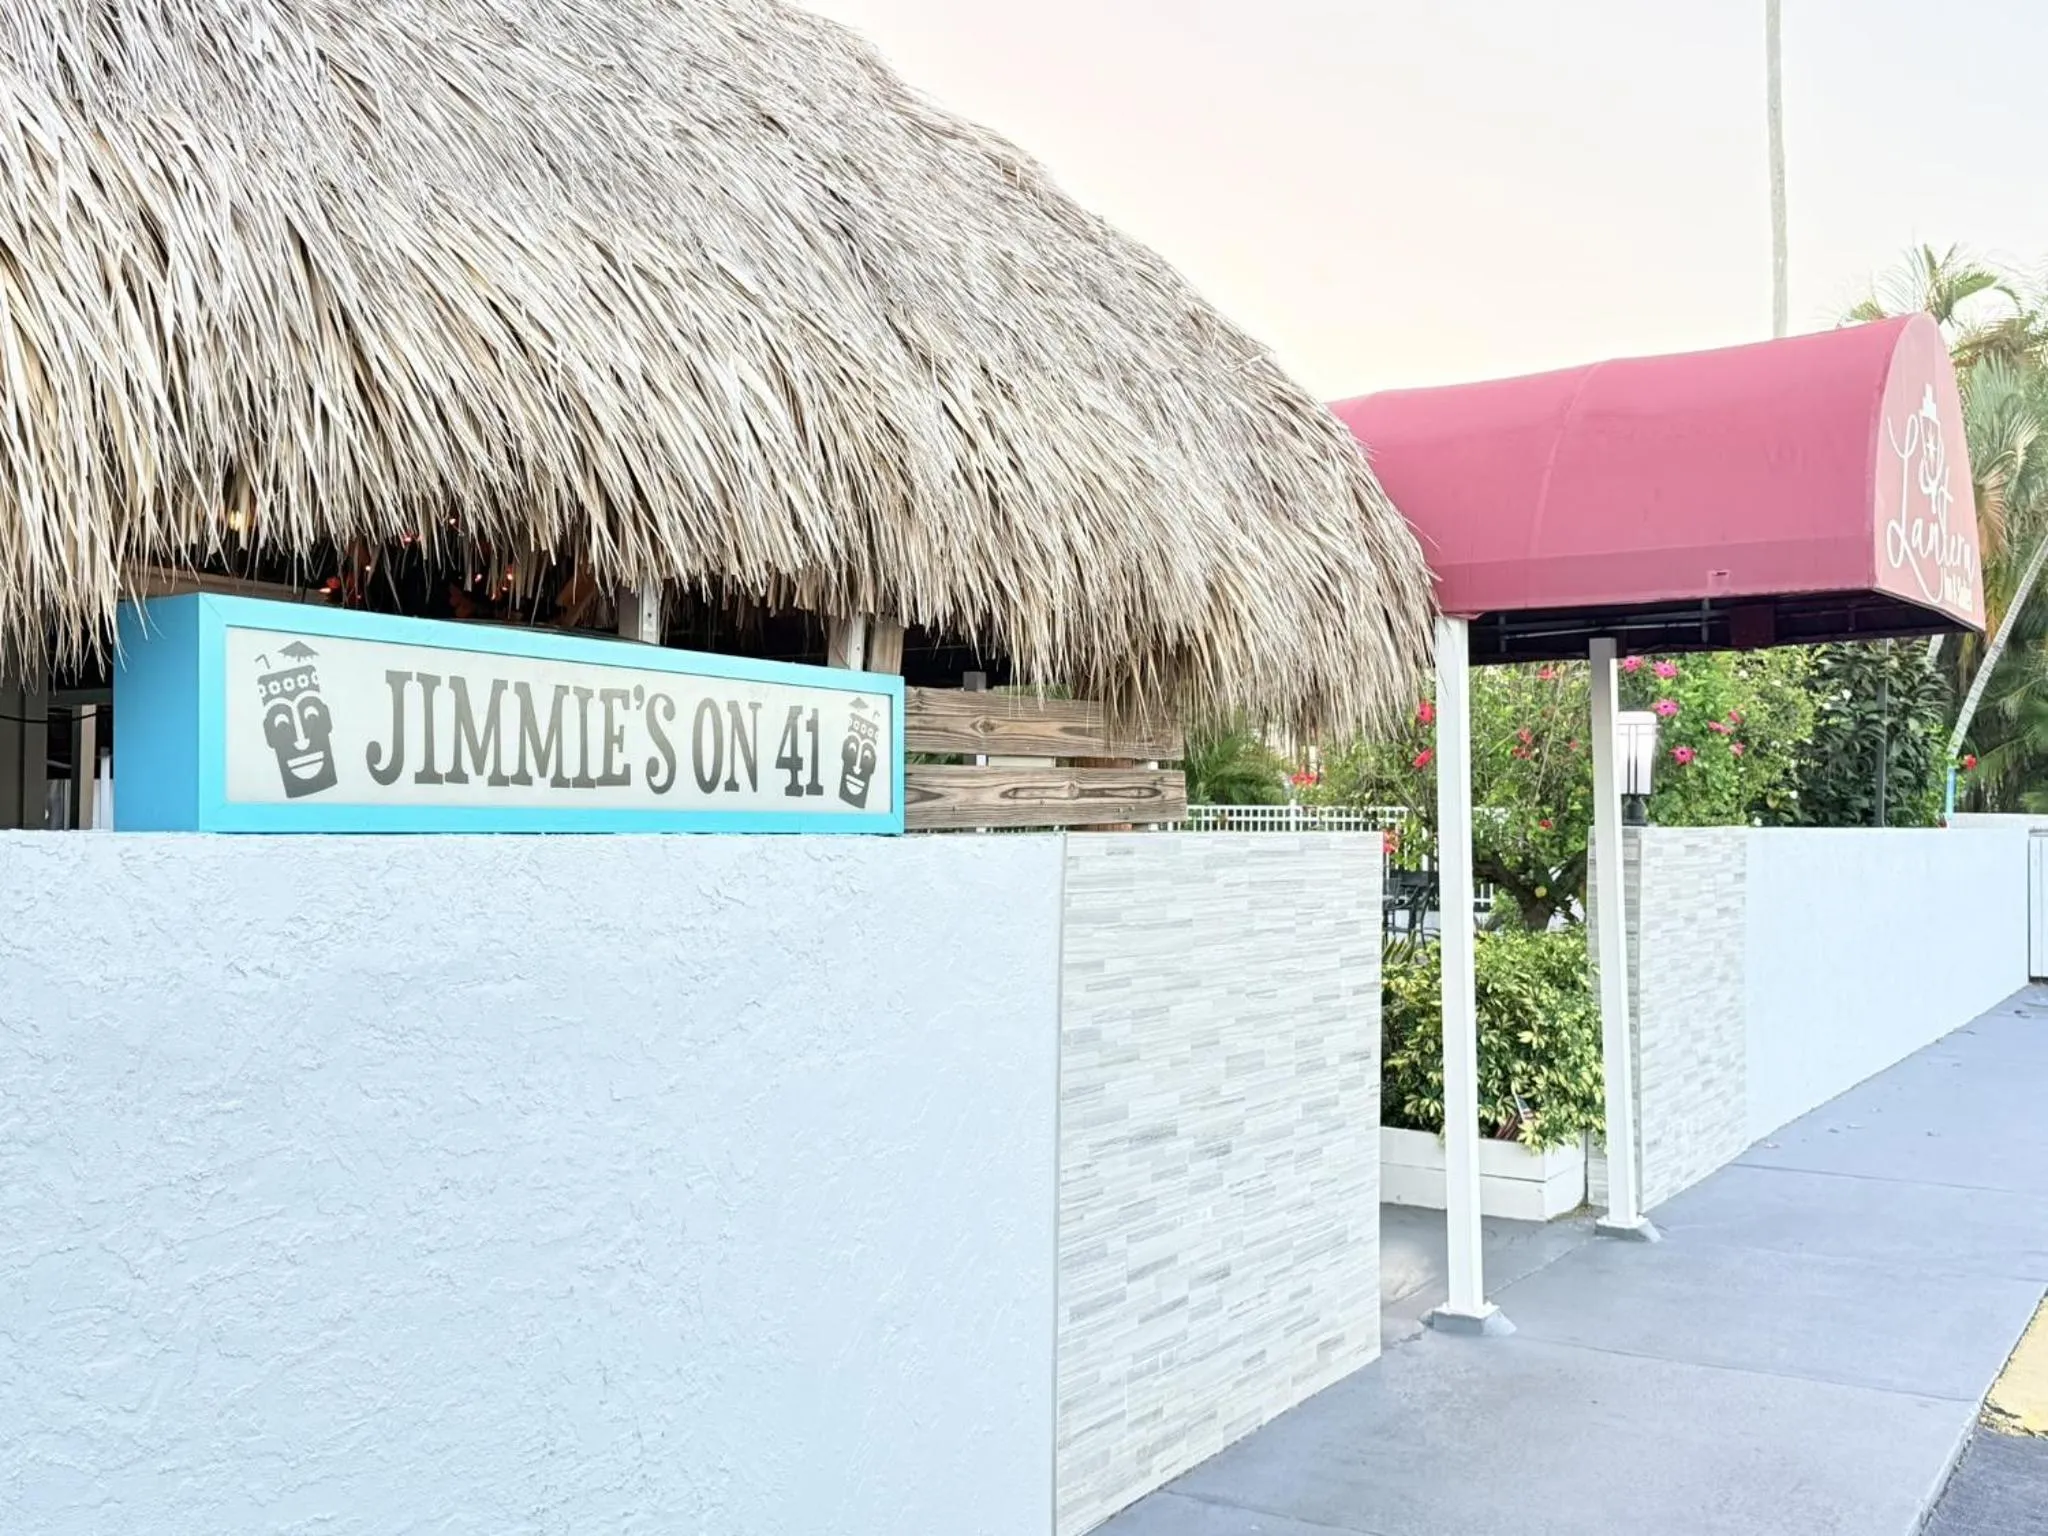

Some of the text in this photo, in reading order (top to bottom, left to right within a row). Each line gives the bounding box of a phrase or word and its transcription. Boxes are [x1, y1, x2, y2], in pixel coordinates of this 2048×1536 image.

[366, 668, 824, 798] JIMMIE'S ON 41
